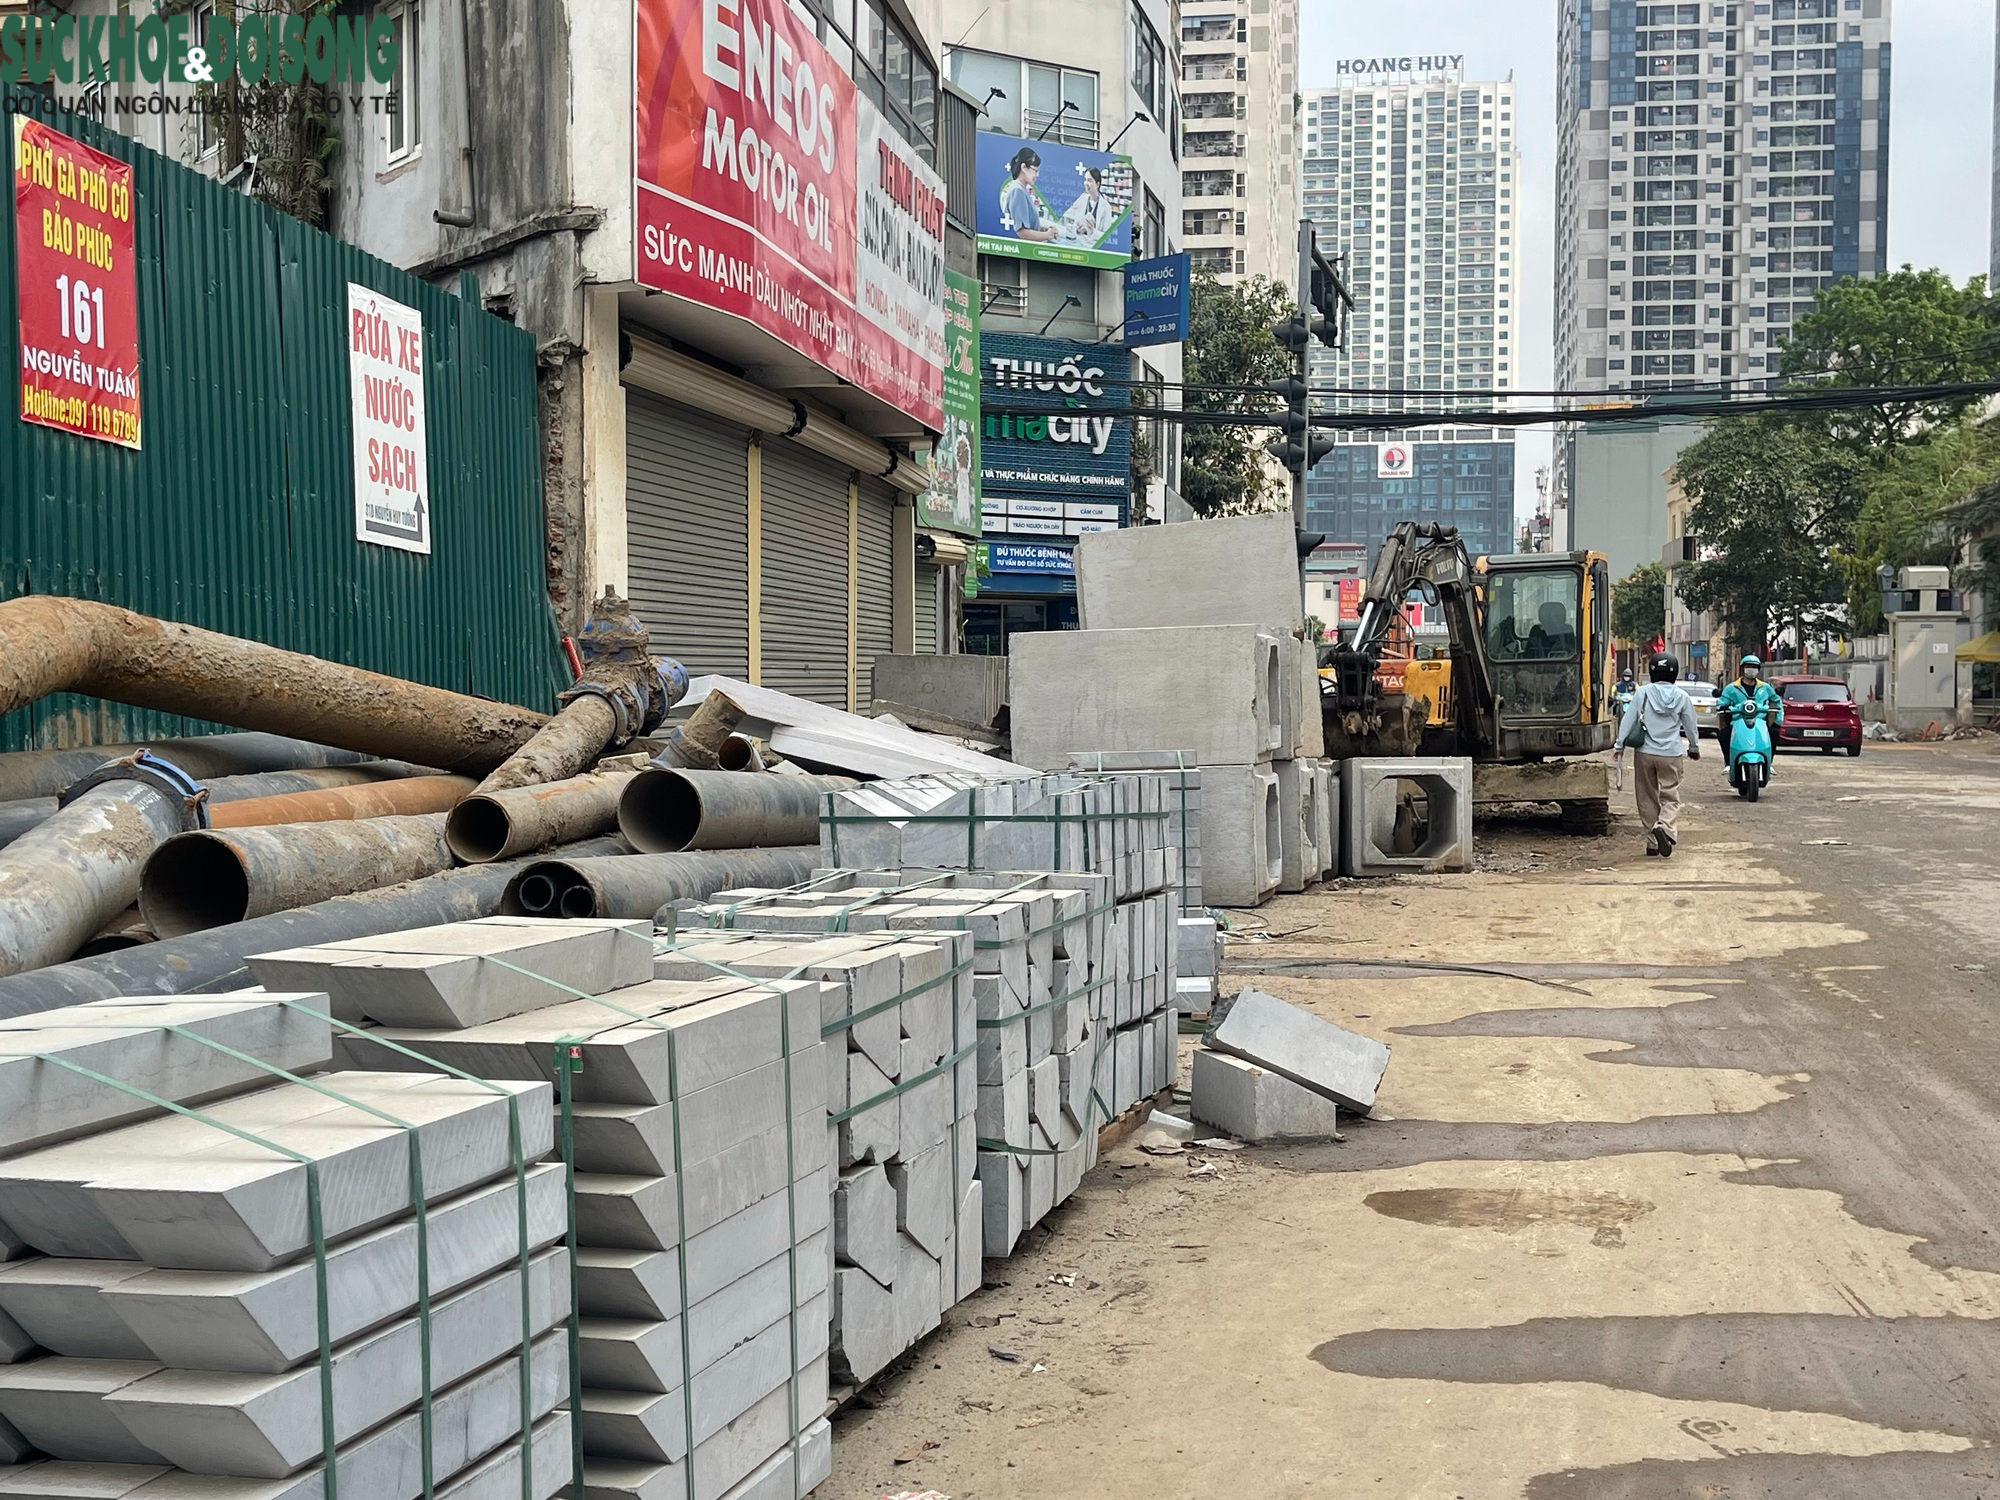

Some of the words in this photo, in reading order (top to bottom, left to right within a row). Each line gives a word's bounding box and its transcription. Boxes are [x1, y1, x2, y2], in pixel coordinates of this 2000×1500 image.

[702, 0, 836, 174] ENEOS
[1337, 57, 1412, 74] HOANG
[1418, 55, 1463, 71] HUY
[21, 136, 53, 191] PHỞ
[56, 154, 77, 201] GÀ
[79, 163, 108, 214] PHỐ
[111, 172, 130, 223] CỔ
[702, 106, 799, 229] MOTOR
[803, 181, 834, 254] OIL
[878, 137, 914, 217] THỊNH
[914, 176, 945, 243] PHÁT
[42, 200, 73, 257] BẢO
[76, 222, 113, 272] PHÚC
[644, 222, 694, 273] SỨC
[698, 245, 755, 297] MẠNH
[756, 261, 779, 313] DẦU
[781, 289, 809, 332] NHỚT
[809, 307, 834, 352] NHẬT
[865, 278, 889, 319] HONDA
[1126, 282, 1179, 302] Pharmacity
[1131, 271, 1148, 284] NHÀ
[1148, 266, 1175, 281] THUỐC
[56, 273, 105, 350] 161
[353, 299, 393, 365] RỬA
[397, 325, 421, 375] XE
[1158, 322, 1176, 333] 23:30
[23, 344, 93, 387] NGUYỄN
[989, 354, 1105, 397] THUỐC
[91, 403, 111, 435] 119
[112, 408, 138, 443] 6789
[364, 374, 415, 433] NƯỚC
[368, 437, 417, 496] SẠCH
[984, 467, 994, 478] VÀ
[995, 470, 1015, 481] THỰC
[1016, 467, 1038, 481] PHẨM
[1039, 471, 1059, 482] CHỨC
[1081, 474, 1104, 485] CHÍNH
[996, 546, 1008, 557] ĐỦ
[1009, 545, 1037, 557] THUỐC
[1037, 547, 1059, 559] BỆNH
